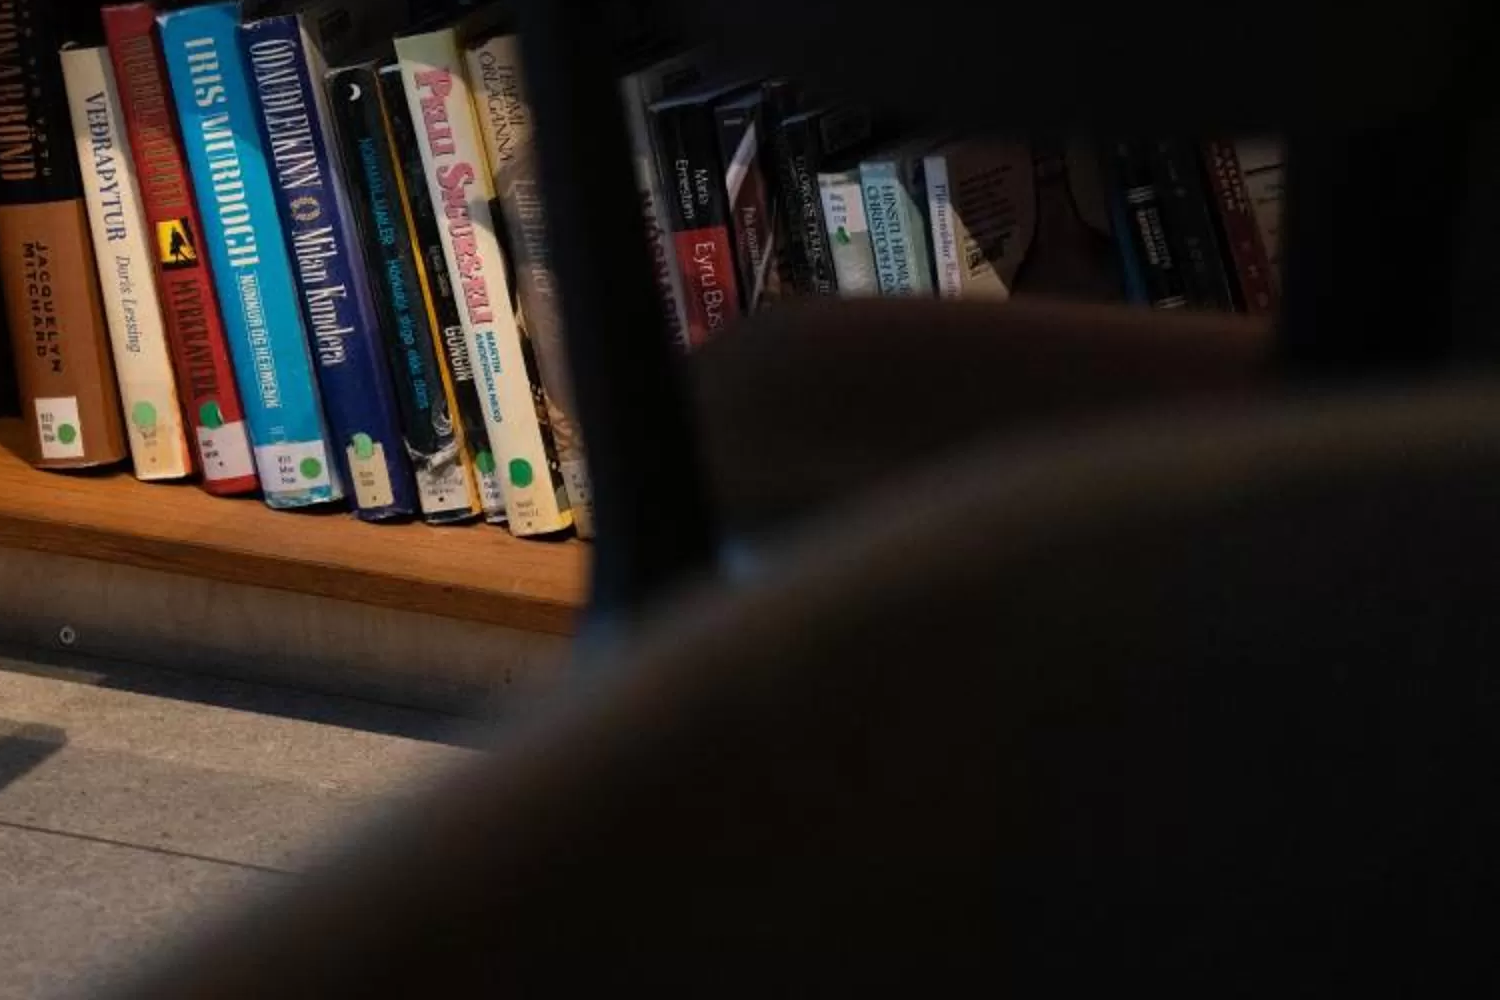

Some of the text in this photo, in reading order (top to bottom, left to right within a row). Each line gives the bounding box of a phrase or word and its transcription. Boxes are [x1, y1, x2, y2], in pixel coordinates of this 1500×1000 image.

[184, 37, 260, 267] IRIS MURDOCH
[116, 255, 133, 294] Doris
[292, 224, 339, 283] Milan
[693, 241, 716, 287] Eyru
[23, 242, 47, 357] MITCHARD
[36, 241, 62, 373] JACQUELYN
[123, 297, 141, 354] Lessing
[305, 282, 355, 367] Kundera
[475, 333, 497, 392] ANDERSEN
[485, 331, 502, 373] MARTIN
